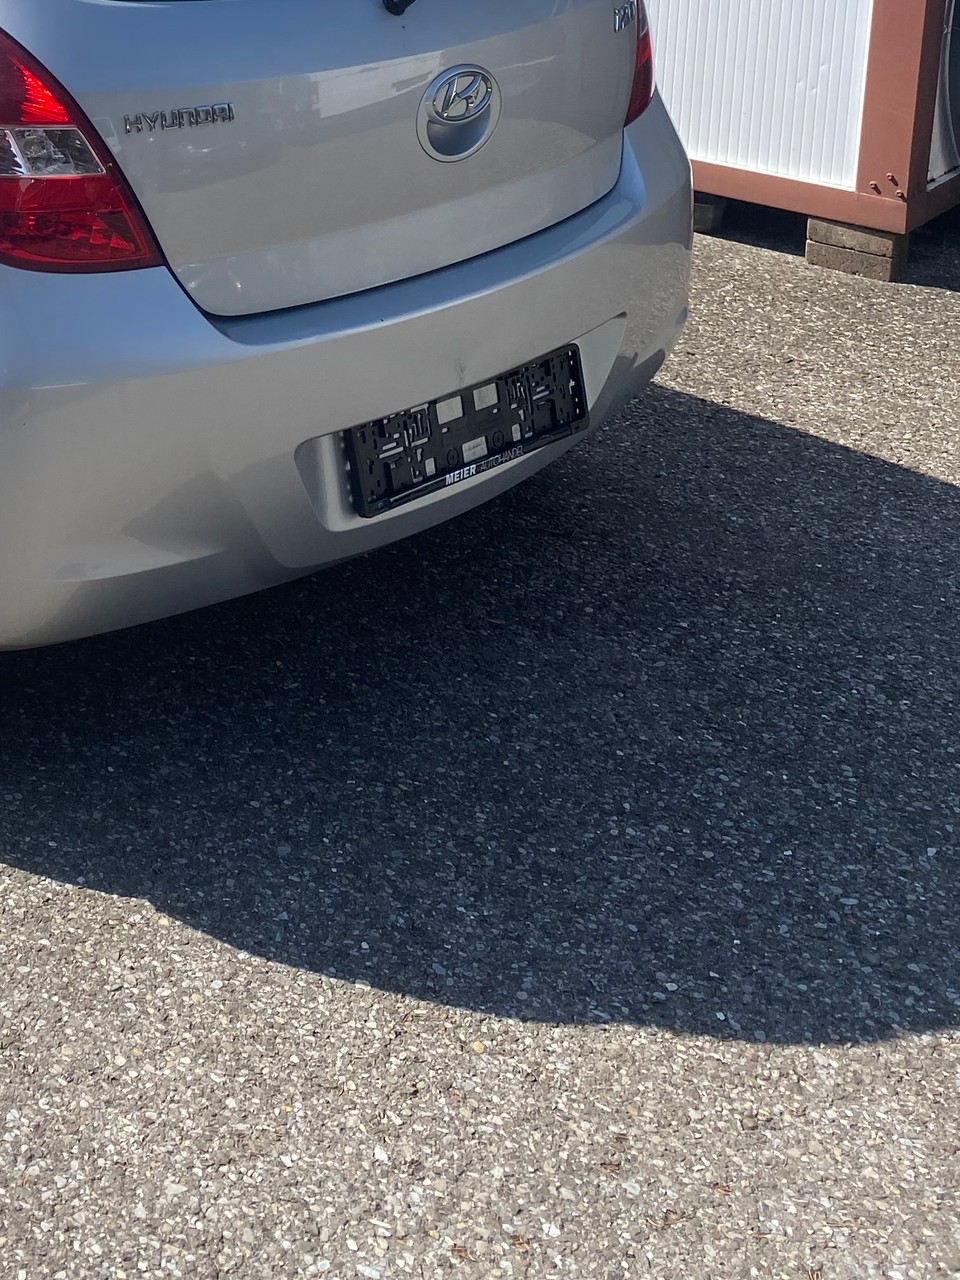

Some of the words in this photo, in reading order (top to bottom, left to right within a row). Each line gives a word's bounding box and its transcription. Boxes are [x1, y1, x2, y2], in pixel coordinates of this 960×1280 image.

[123, 102, 236, 135] HYUNDAI
[445, 464, 477, 486] MEIER
[480, 445, 524, 471] AUTOHANDEL
